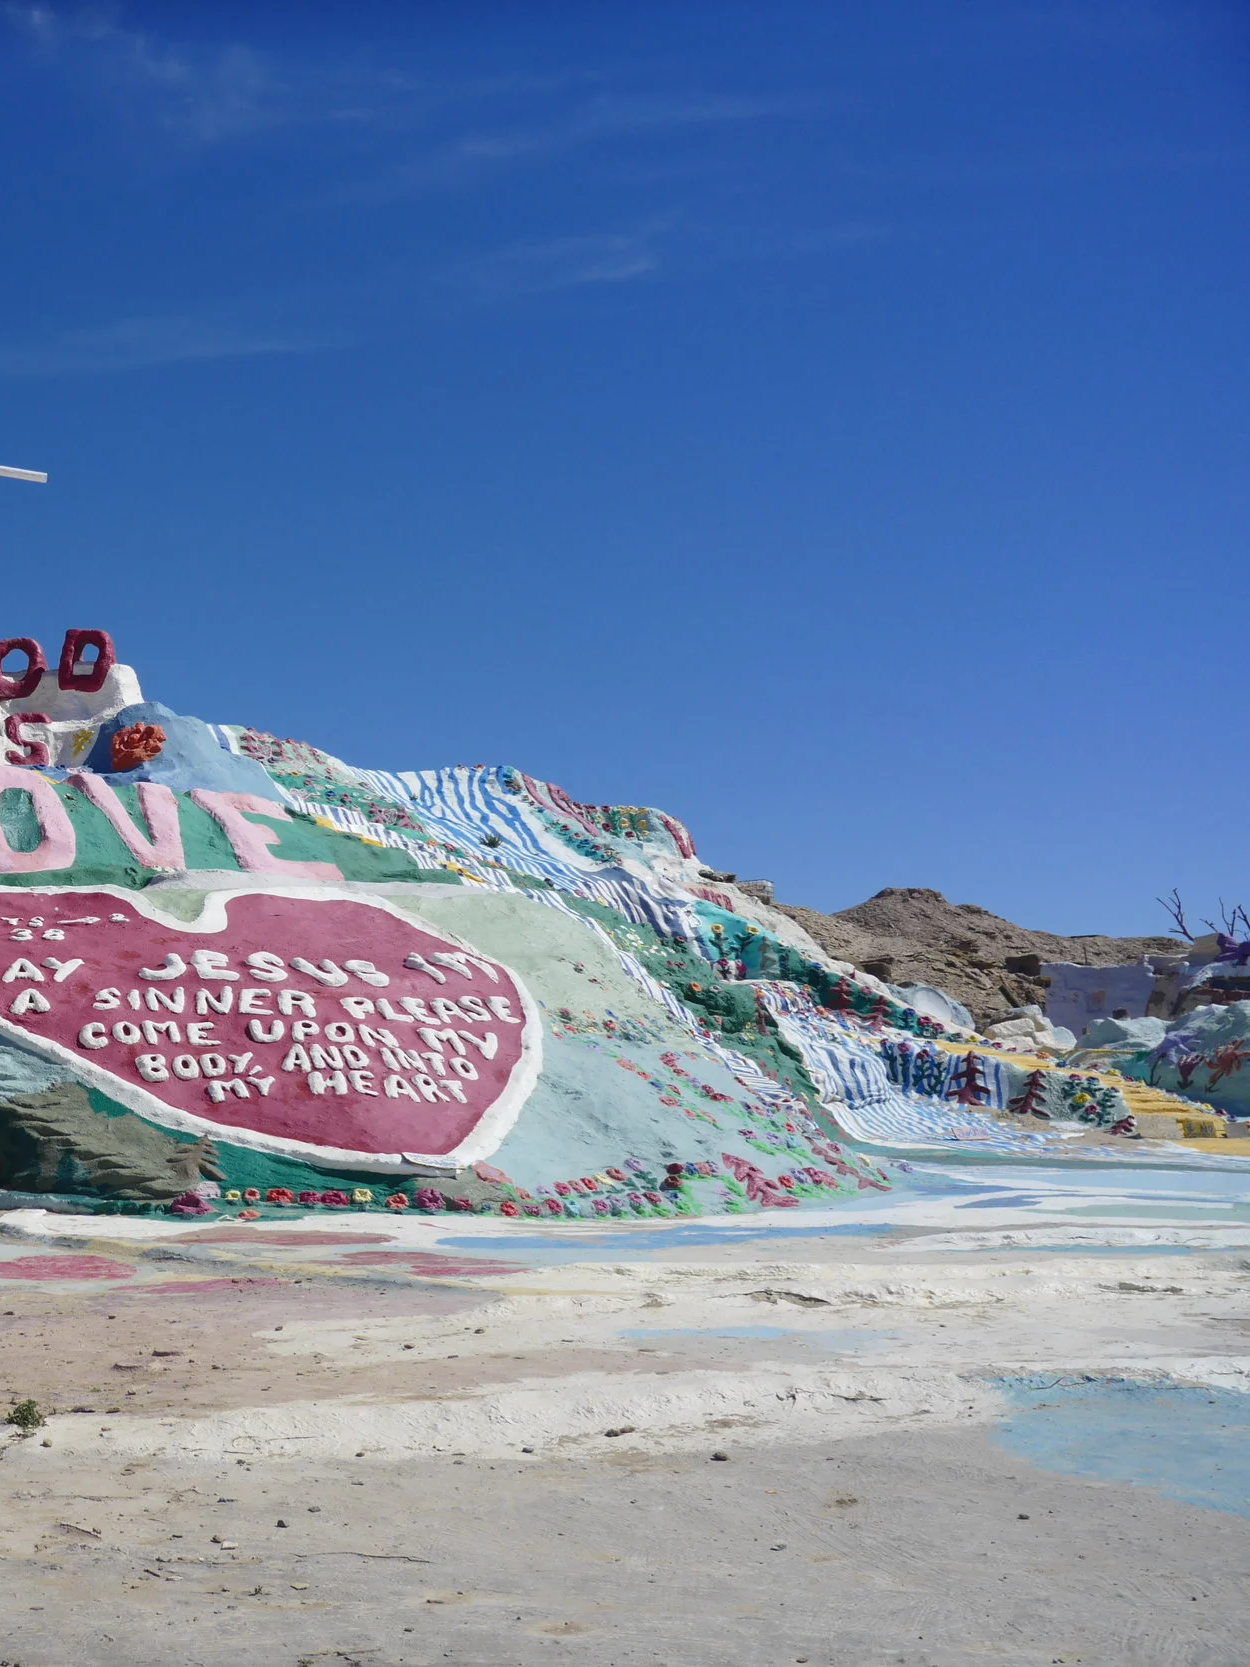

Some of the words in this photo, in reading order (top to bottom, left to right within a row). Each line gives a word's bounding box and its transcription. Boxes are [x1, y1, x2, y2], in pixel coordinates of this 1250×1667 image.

[9, 928, 65, 941] 38
[138, 949, 390, 988] JESUS
[9, 988, 51, 1016] A
[92, 986, 316, 1018] SINNER
[340, 994, 521, 1025] PLEASE
[78, 1019, 222, 1050] COME
[248, 1018, 400, 1048] UPON
[416, 1026, 498, 1060] MY
[281, 1043, 370, 1073] AND
[379, 1047, 480, 1081] INTO
[207, 1076, 276, 1103] MY
[307, 1070, 468, 1104] HEART
